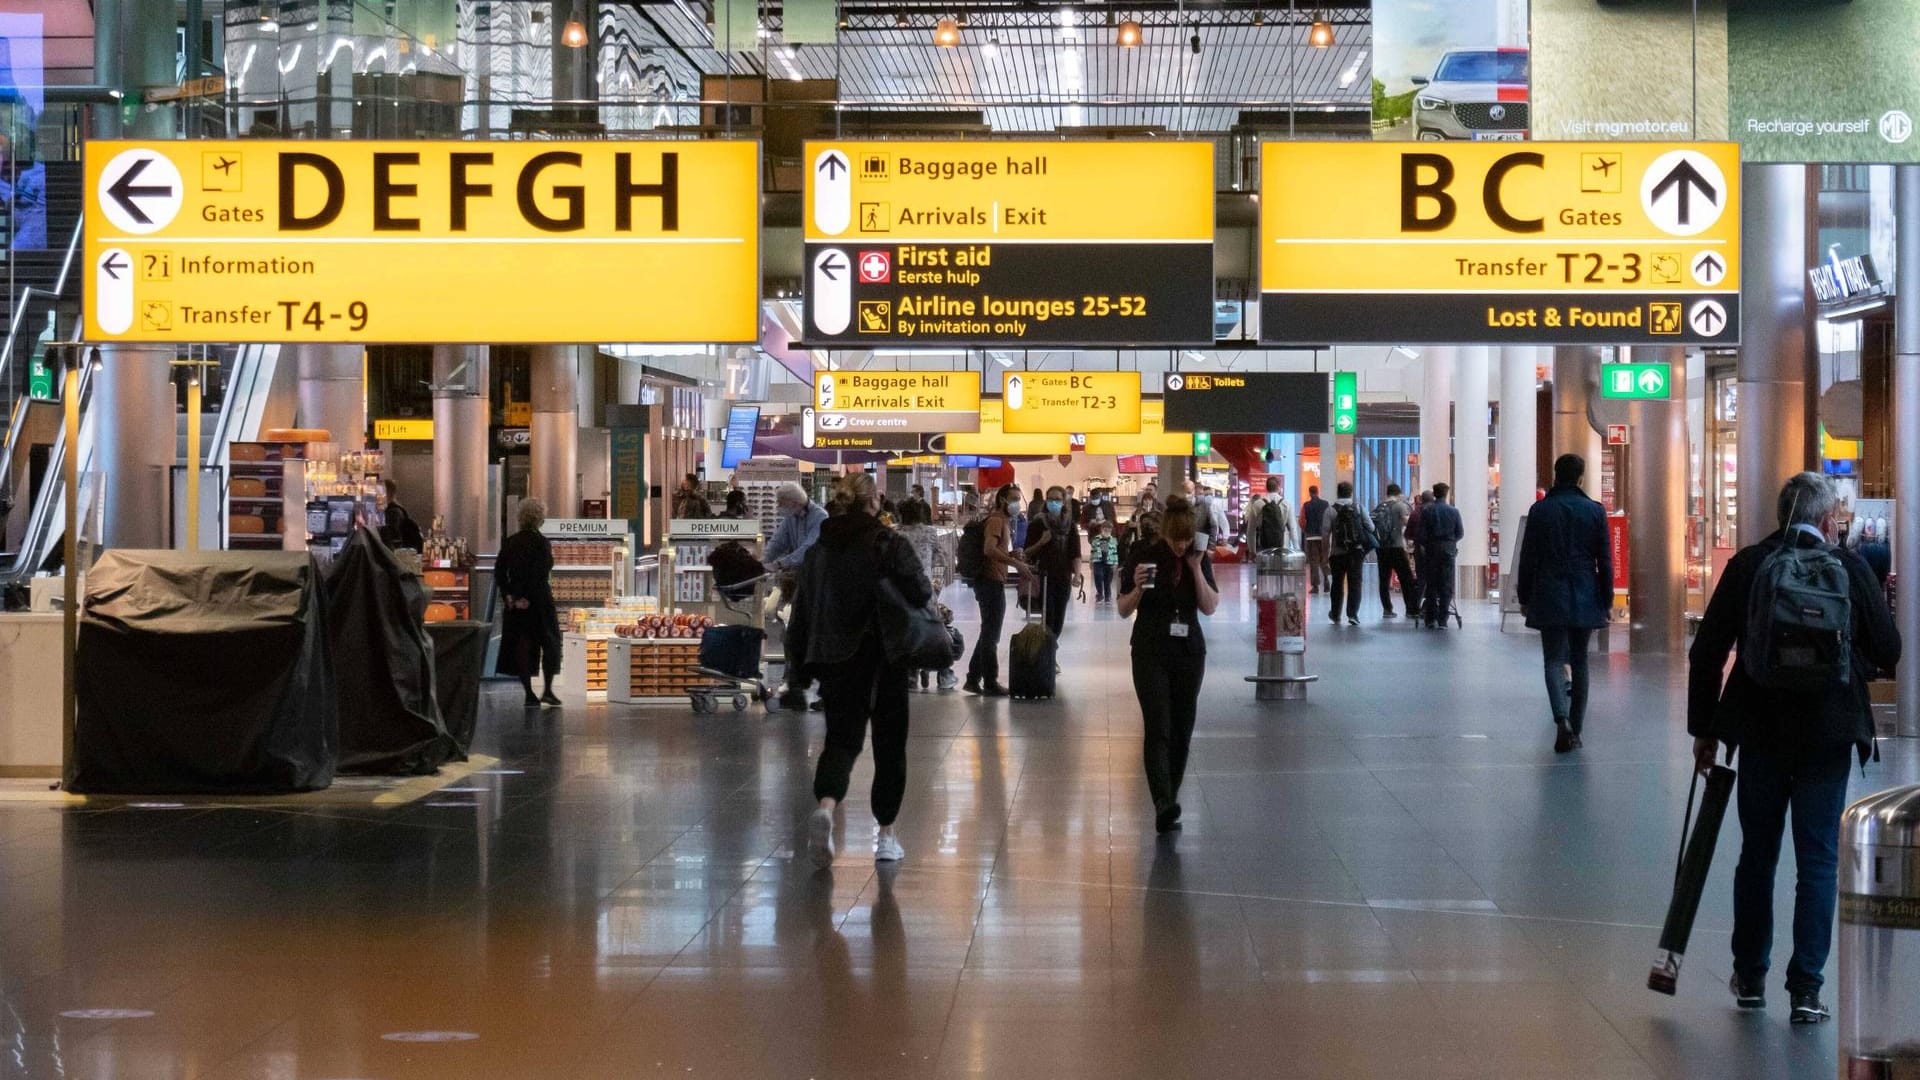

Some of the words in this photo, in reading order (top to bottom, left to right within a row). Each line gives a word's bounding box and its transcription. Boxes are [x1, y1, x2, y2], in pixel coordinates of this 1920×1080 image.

[1560, 119, 1592, 134] Visit
[1596, 120, 1688, 136] mgmotor.eu
[1748, 119, 1813, 136] Recharge
[1815, 119, 1870, 135] yourself
[900, 158, 997, 179] Baggage
[1007, 157, 1046, 174] hall
[202, 205, 263, 222] Gates
[279, 152, 345, 230] D
[373, 152, 420, 231] E
[450, 153, 493, 231] F
[517, 151, 585, 232] G
[615, 152, 678, 231] H
[1401, 153, 1456, 232] B
[1483, 152, 1544, 233] C
[1560, 209, 1621, 225] Gates
[899, 207, 986, 224] Arrivals
[1006, 208, 1046, 225] Exit
[899, 246, 948, 265] First
[955, 246, 990, 266] aid
[182, 256, 313, 274] Information
[1456, 258, 1547, 275] Transfer
[1557, 253, 1641, 283] T2-3
[899, 270, 942, 283] Eerste
[947, 270, 979, 286] hulp
[180, 306, 271, 323] Transfer
[278, 301, 368, 331] T4-9
[898, 296, 975, 315] Airline
[984, 296, 1075, 319] lounges
[1083, 297, 1146, 316] 25-52
[1488, 308, 1536, 326] Lost
[1544, 308, 1562, 327] &
[1569, 307, 1641, 326] Found
[899, 320, 915, 336] By
[921, 320, 990, 333] invitation
[995, 320, 1026, 336] only
[727, 363, 750, 395] T2
[854, 376, 916, 390] Baggage
[922, 375, 948, 387] hall
[1071, 376, 1079, 388] B
[1083, 376, 1092, 388] C
[1214, 378, 1244, 386] Toilets
[853, 395, 909, 407] Arrivals
[917, 396, 944, 407] Exit
[1042, 398, 1079, 406] Transfer
[1081, 396, 1115, 409] T2-3
[850, 417, 874, 425] Crew
[877, 418, 907, 426] centre
[827, 438, 842, 446] Lost
[559, 523, 608, 533] PREMIUM
[691, 523, 739, 533] PREMIUM
